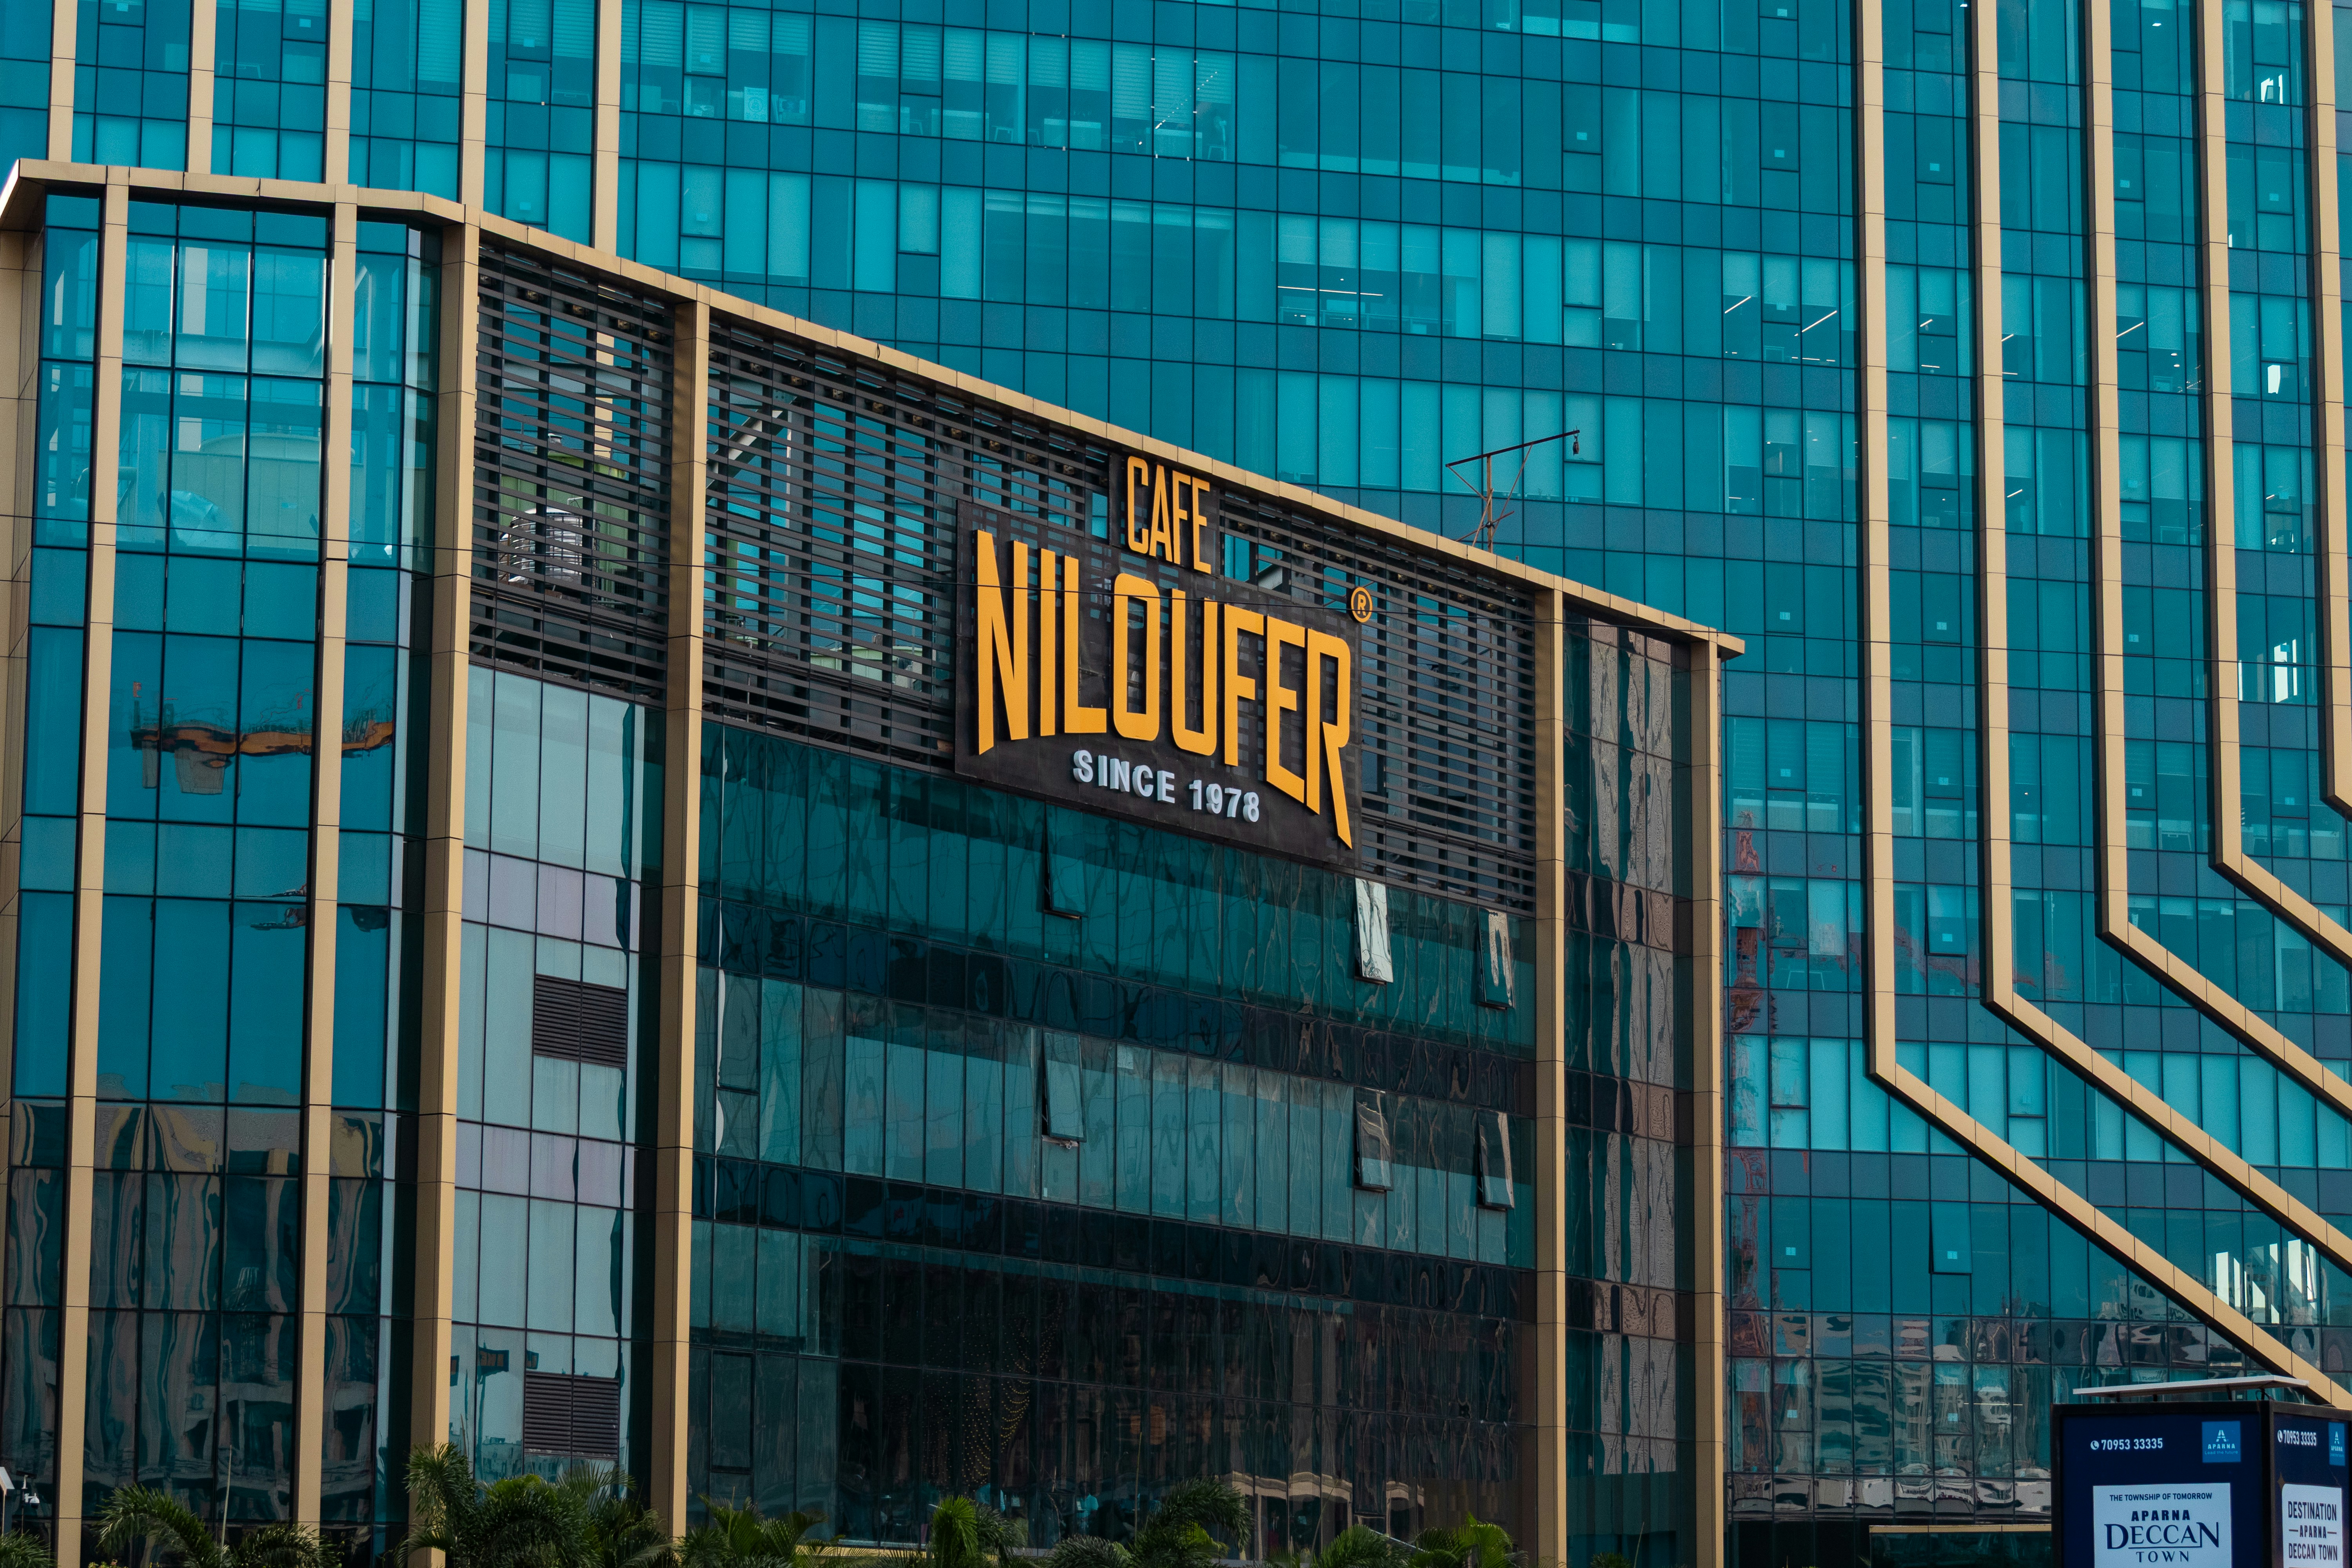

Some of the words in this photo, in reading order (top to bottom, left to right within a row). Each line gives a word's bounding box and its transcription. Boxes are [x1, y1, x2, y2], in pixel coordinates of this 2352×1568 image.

[1127, 456, 1212, 575] CAFE
[976, 529, 1352, 849] NILOUFER
[1073, 750, 1175, 804] SINCE
[1189, 779, 1259, 822] 1978
[2101, 1439, 2131, 1450] 70953
[2133, 1437, 2163, 1450] 33335
[2283, 1430, 2299, 1445] 70953
[2300, 1431, 2317, 1446] 33335
[2131, 1509, 2190, 1521] APARNA
[2288, 1501, 2337, 1521] DESTINATION
[2104, 1521, 2219, 1550] DECCAN
[2299, 1525, 2327, 1539] APARNA
[2136, 1550, 2189, 1563] TOWN
[2288, 1543, 2316, 1560] DECCAN
[2318, 1544, 2337, 1561] TOWN
